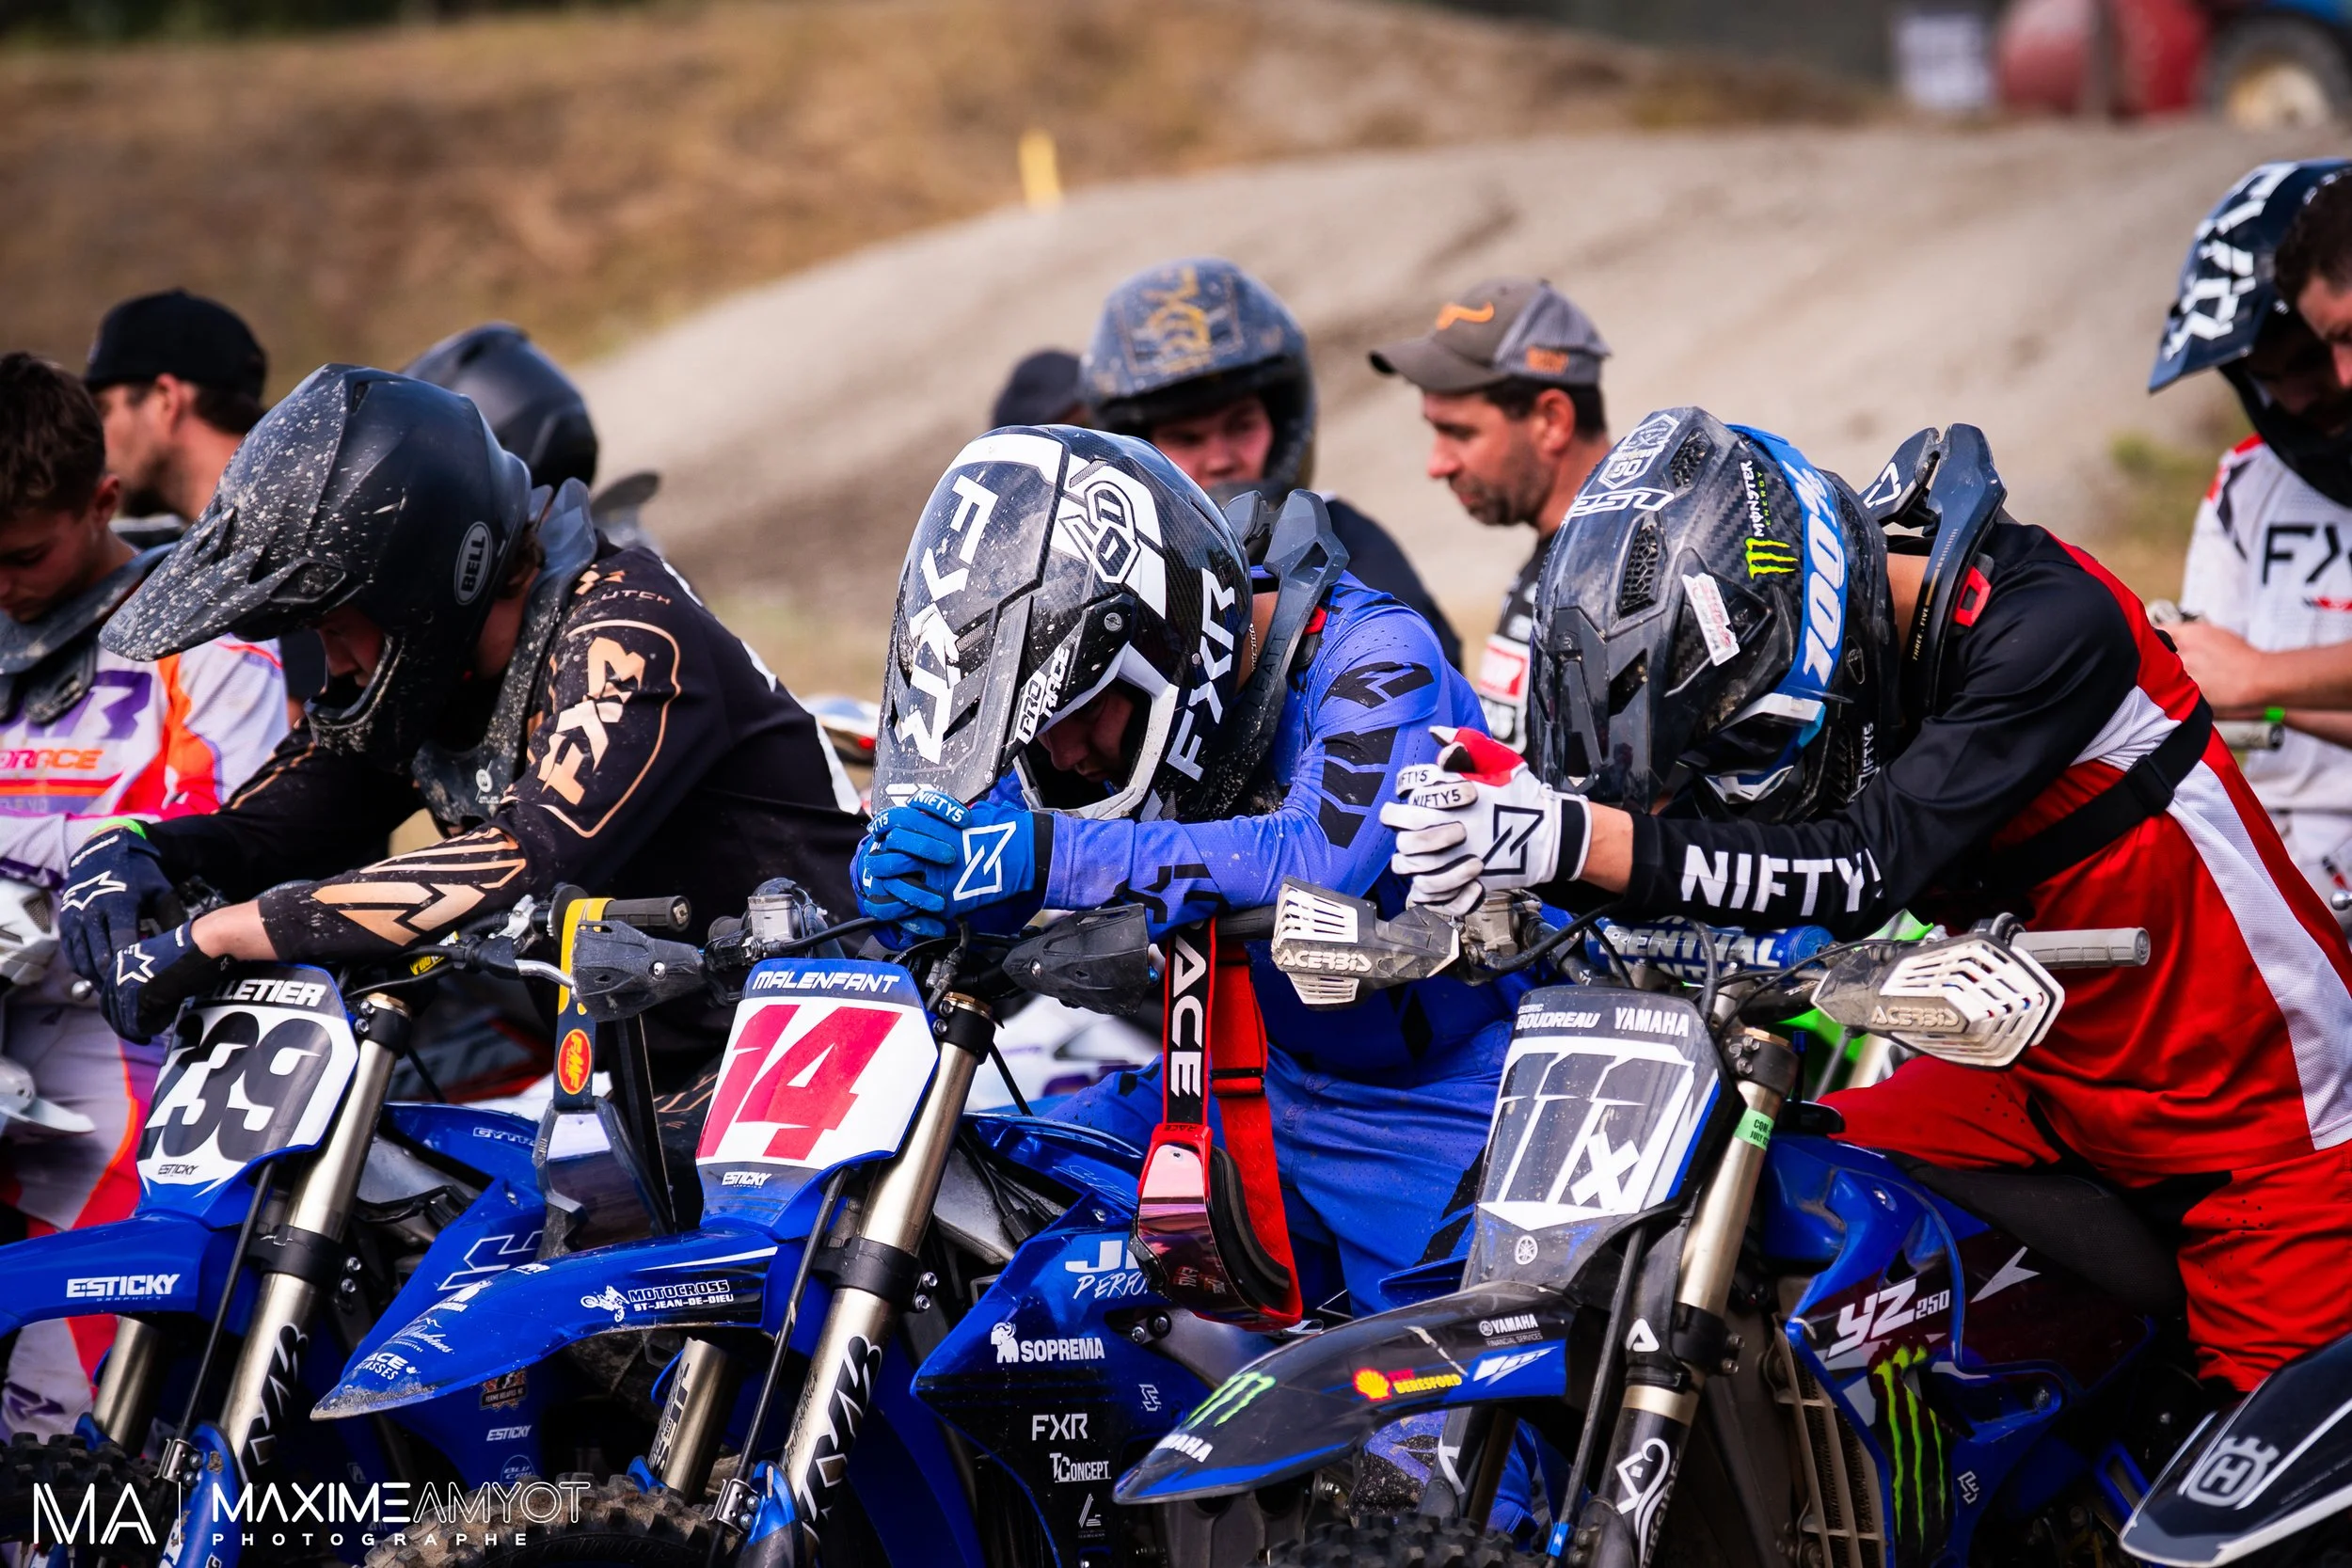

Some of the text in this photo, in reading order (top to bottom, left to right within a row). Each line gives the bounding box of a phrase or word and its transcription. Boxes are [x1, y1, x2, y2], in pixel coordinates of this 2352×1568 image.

[1740, 460, 1765, 537] MONSTER
[1756, 471, 1772, 527] ENERGY
[460, 535, 486, 594] BELL
[1913, 608, 1930, 661] THREE FIVE
[1166, 567, 1235, 783] FXR
[1254, 633, 1286, 709] LEATT
[911, 790, 965, 823] NIFTY5
[1412, 788, 1462, 807] NIFTY5
[752, 971, 900, 993] MALENFANT
[1516, 1006, 1690, 1037] BOUDREAU YAMAHA
[1518, 1003, 1545, 1014] CEDRIC
[569, 1034, 585, 1090] FMF
[695, 1004, 903, 1161] 14
[628, 1279, 730, 1303] MOTOCROSS
[633, 1293, 734, 1312] ST-JEAN-DE-DIEU
[1915, 1290, 1950, 1321] 250
[1486, 1332, 1544, 1347] FINANCIAL SERVICES
[1491, 1314, 1539, 1335] YAMAHA
[1021, 1338, 1105, 1362] SOPREMA
[1393, 1373, 1463, 1394] BERESFORD
[1031, 1413, 1088, 1441] FXR
